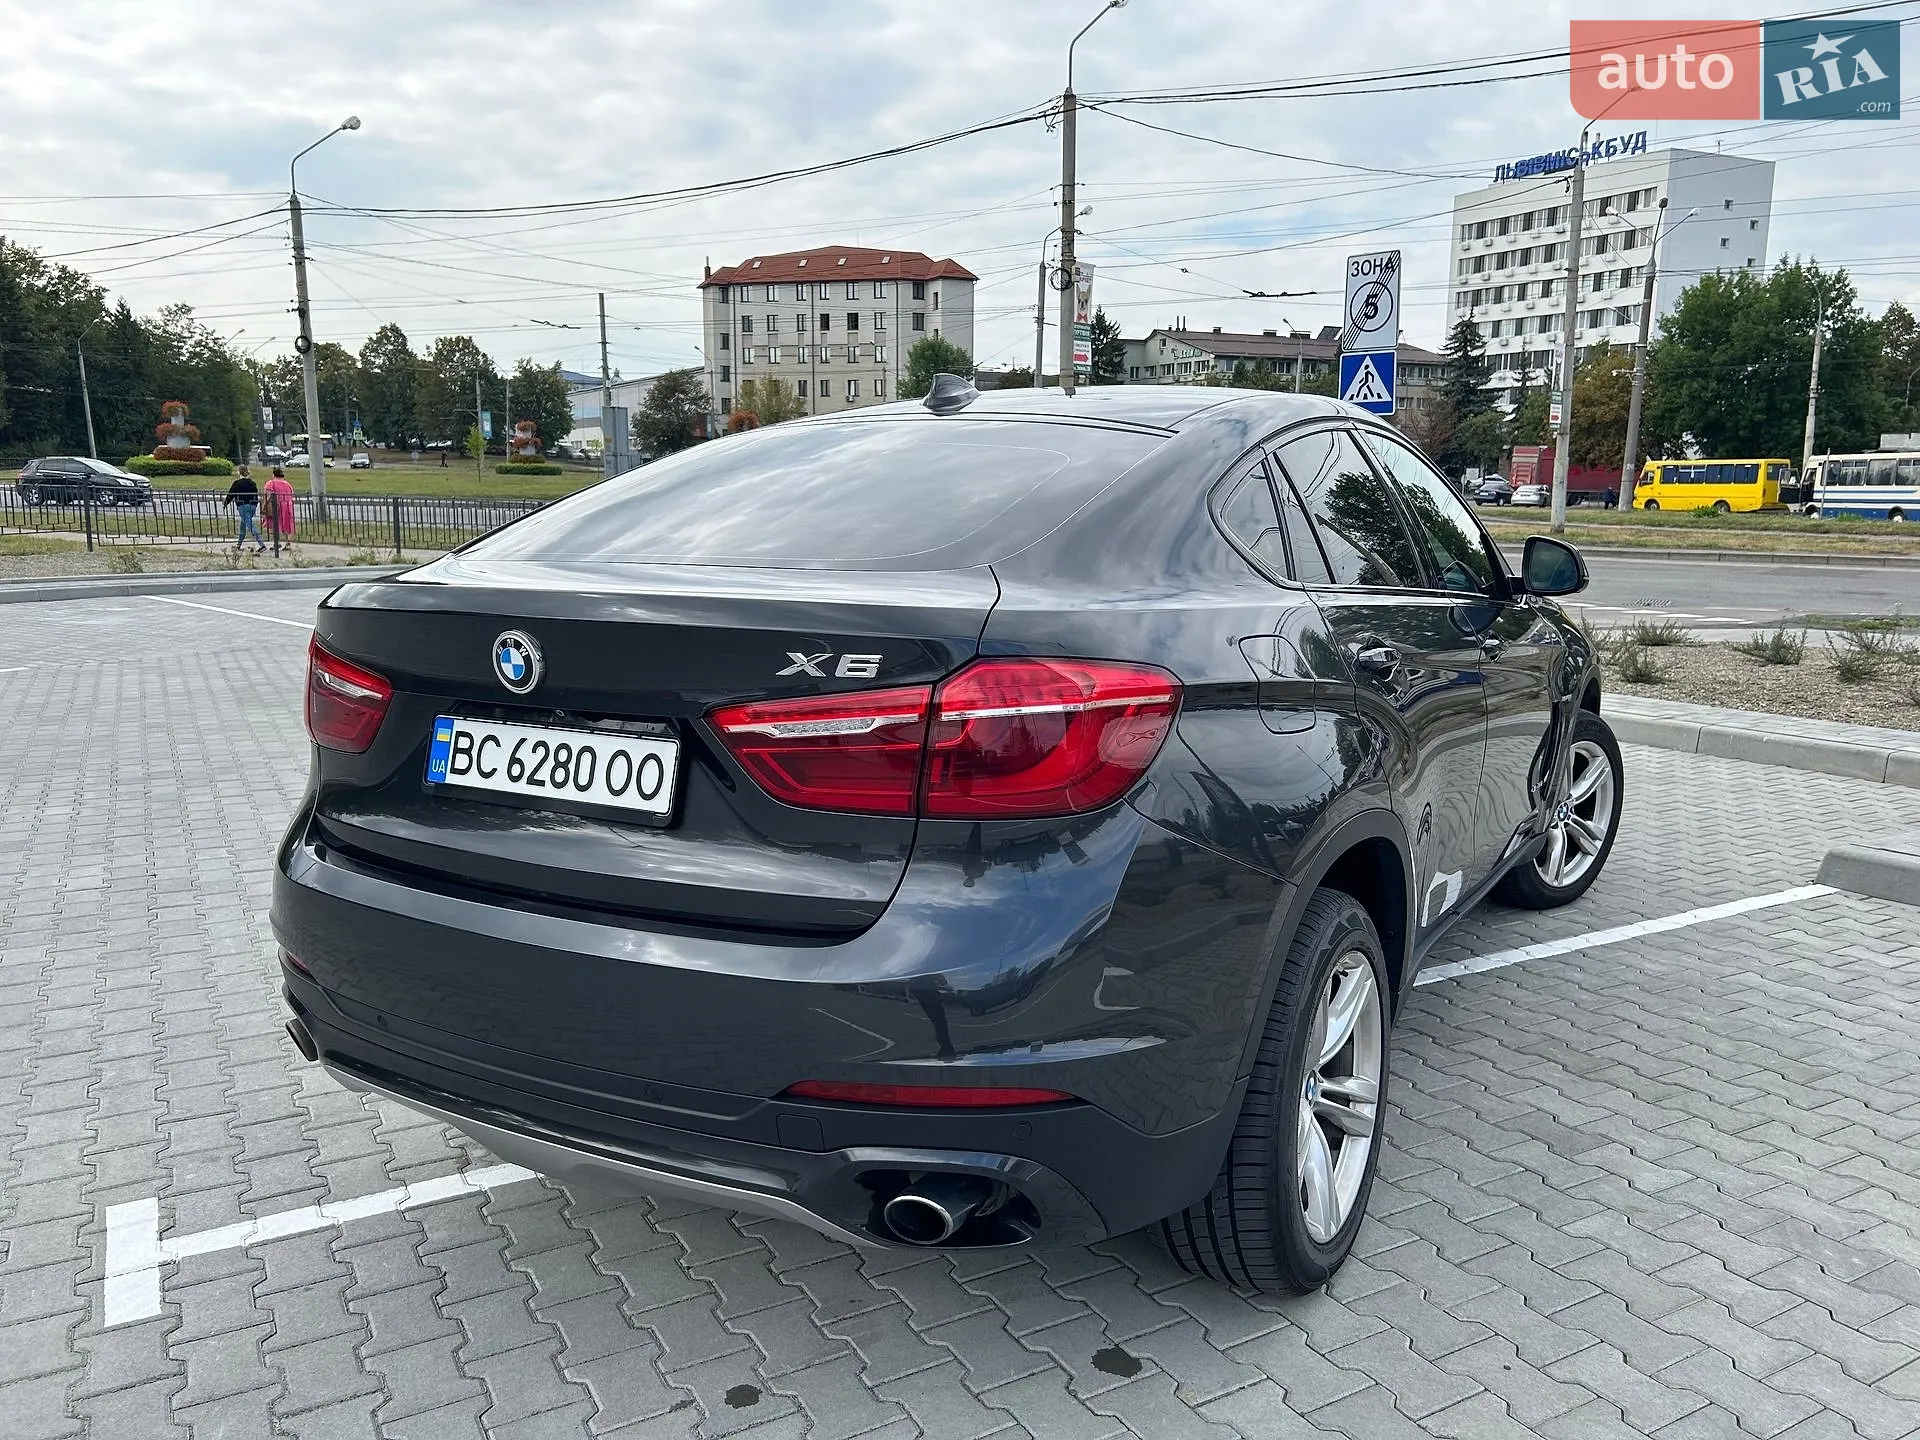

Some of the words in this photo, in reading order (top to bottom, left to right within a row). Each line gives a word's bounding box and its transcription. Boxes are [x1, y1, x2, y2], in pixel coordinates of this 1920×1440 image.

[1351, 257, 1395, 277] ЗОНА
[775, 652, 884, 678] X6
[431, 758, 446, 774] UA
[450, 730, 502, 779] BC
[507, 737, 597, 793] 6280
[605, 749, 665, 801] OO
